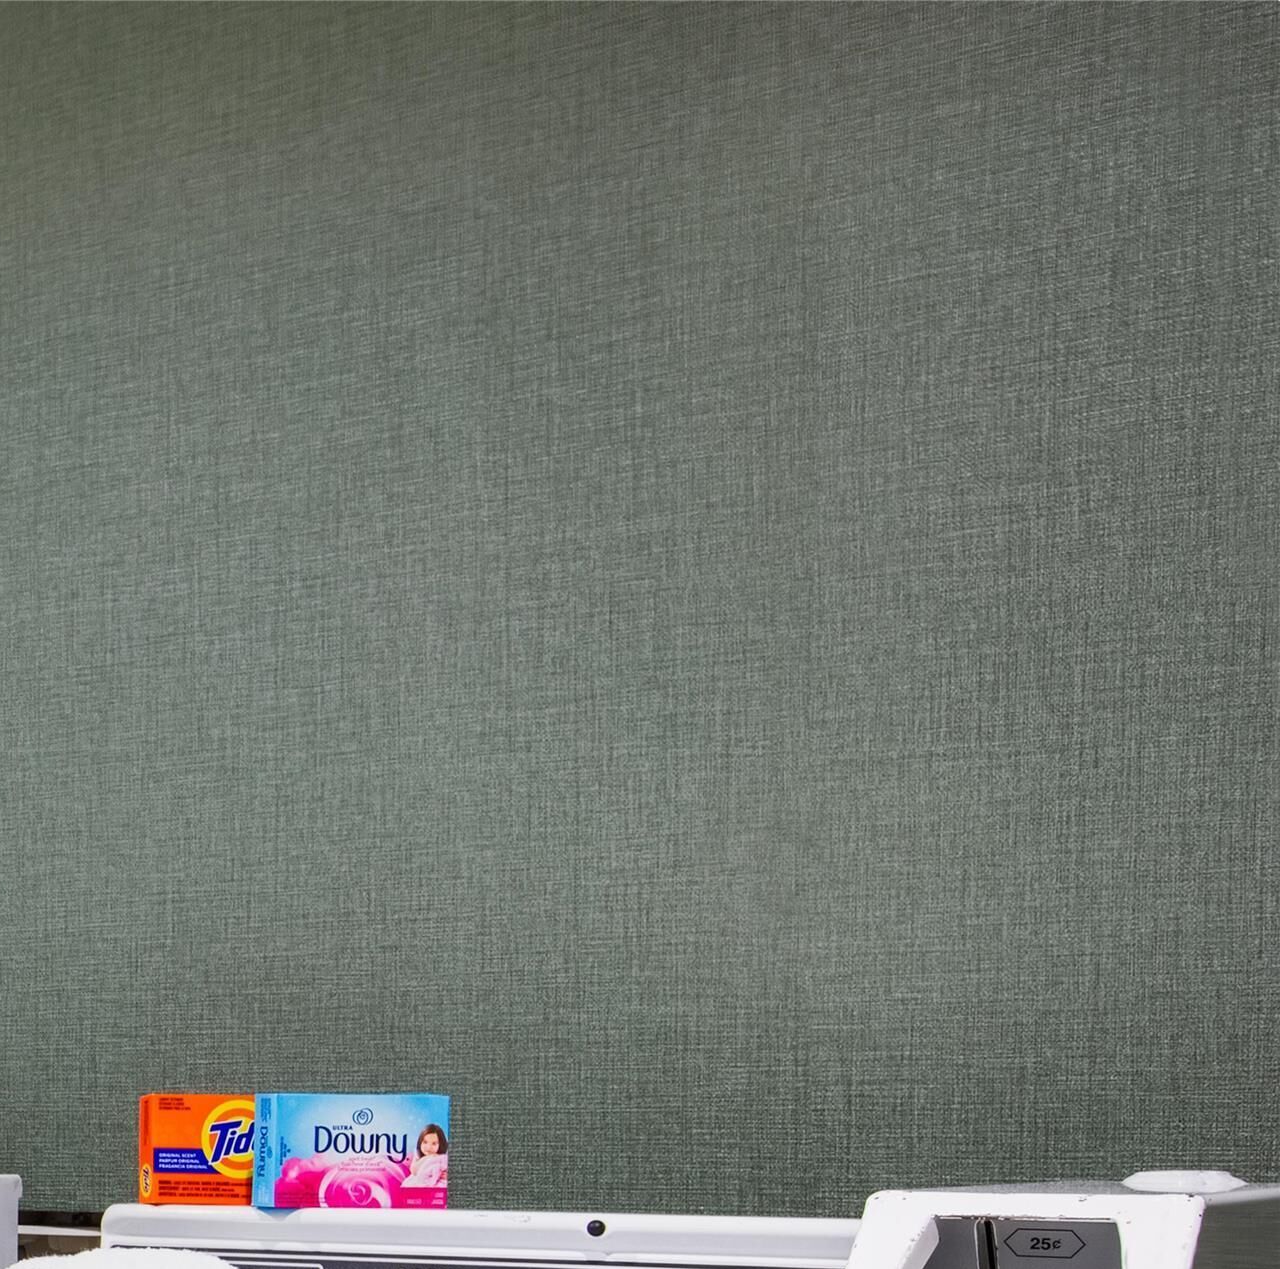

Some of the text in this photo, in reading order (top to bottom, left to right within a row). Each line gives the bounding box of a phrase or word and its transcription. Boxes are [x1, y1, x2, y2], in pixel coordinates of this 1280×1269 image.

[208, 1119, 255, 1165] Tid
[257, 1126, 269, 1177] Downy
[314, 1125, 407, 1164] Downy
[1030, 1237, 1062, 1251] 25¢
